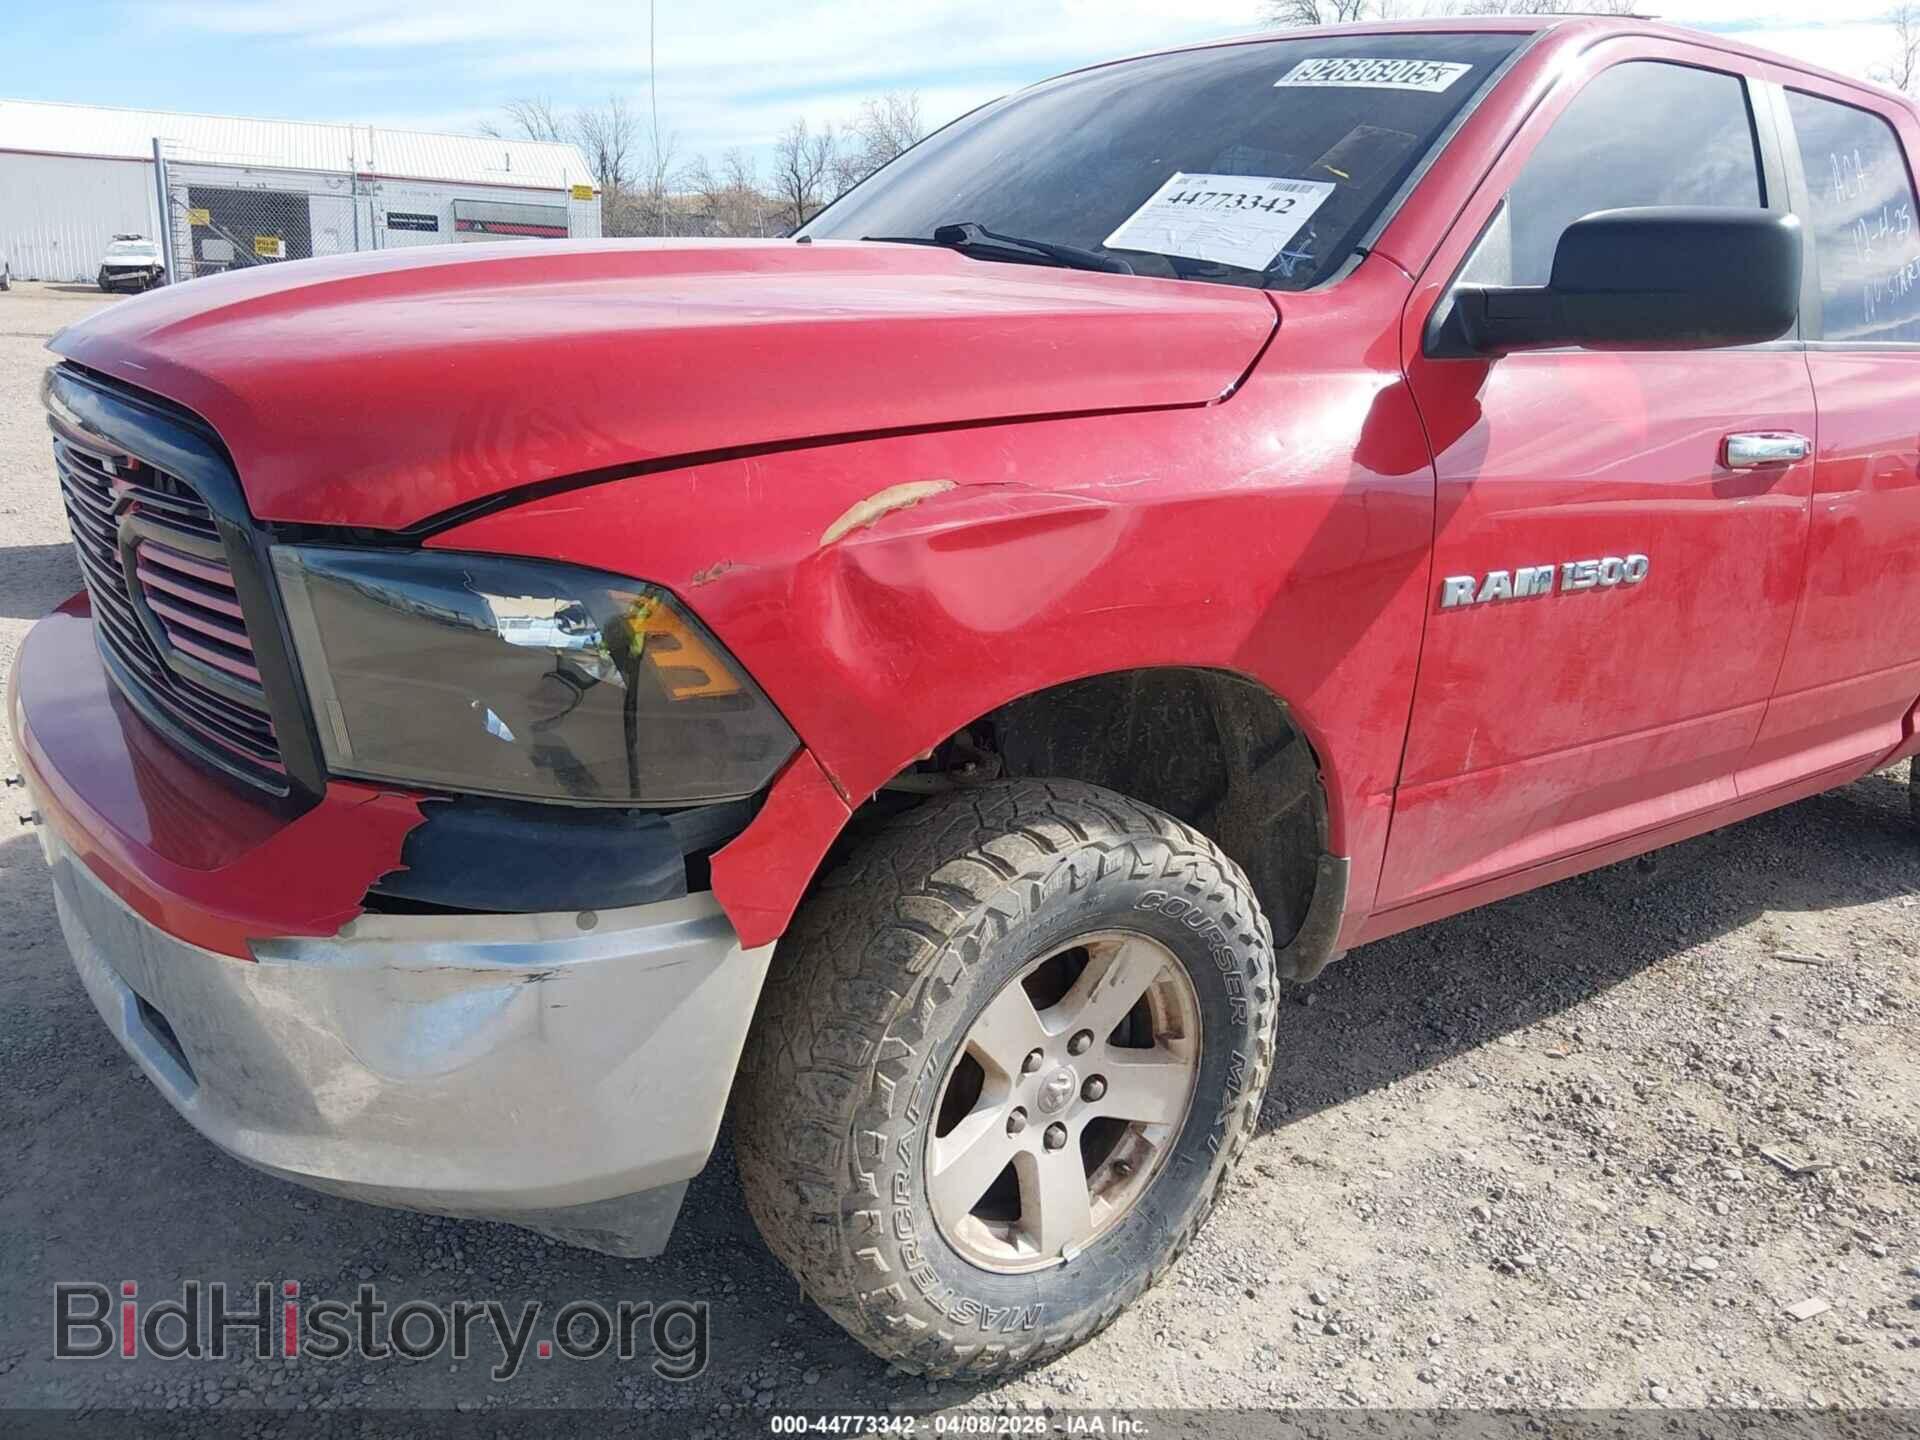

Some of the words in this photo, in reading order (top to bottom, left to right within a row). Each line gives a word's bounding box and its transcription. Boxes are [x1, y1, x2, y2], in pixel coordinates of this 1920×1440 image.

[1167, 190, 1297, 215] 44773342
[1440, 564, 1556, 609] RAM
[1560, 553, 1650, 592] 1500
[1133, 889, 1249, 1026] COURSER
[892, 1036, 1043, 1332] MASTERCRAFT
